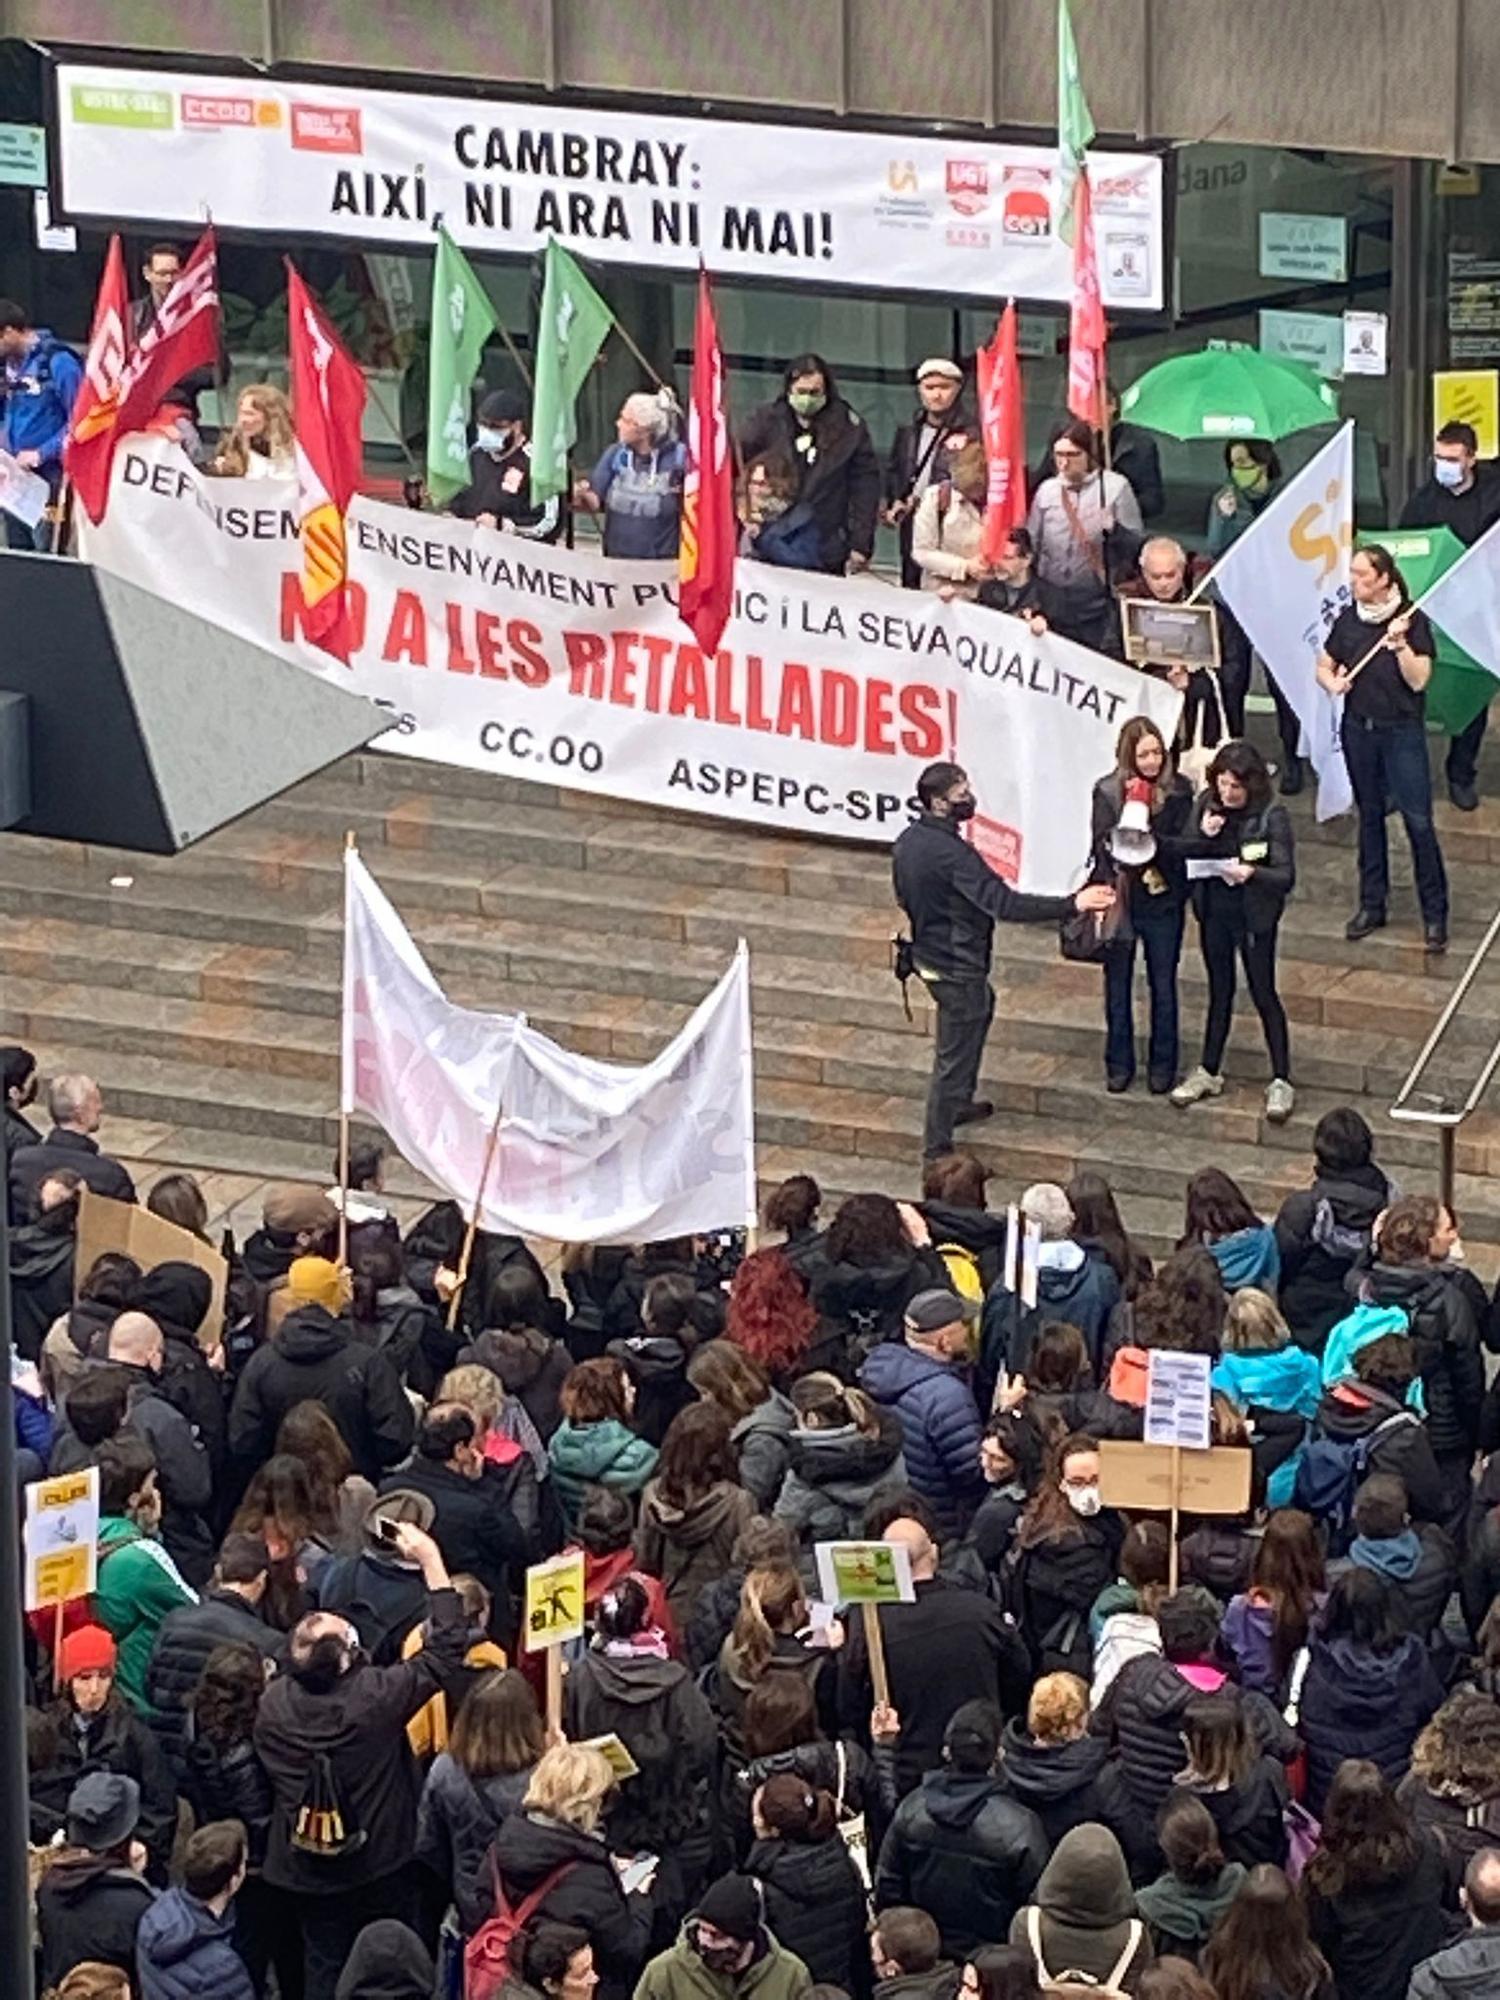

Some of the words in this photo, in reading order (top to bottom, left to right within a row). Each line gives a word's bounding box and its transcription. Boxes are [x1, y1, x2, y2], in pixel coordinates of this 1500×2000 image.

[454, 124, 700, 190] CAMBRAY:
[465, 181, 511, 231] NI
[534, 189, 631, 242] ARA
[652, 199, 700, 247] NI
[722, 205, 833, 260] MAI!
[802, 600, 847, 638] LA
[381, 588, 428, 667] A
[445, 602, 551, 688] LES
[562, 629, 958, 769] RETALLADES!
